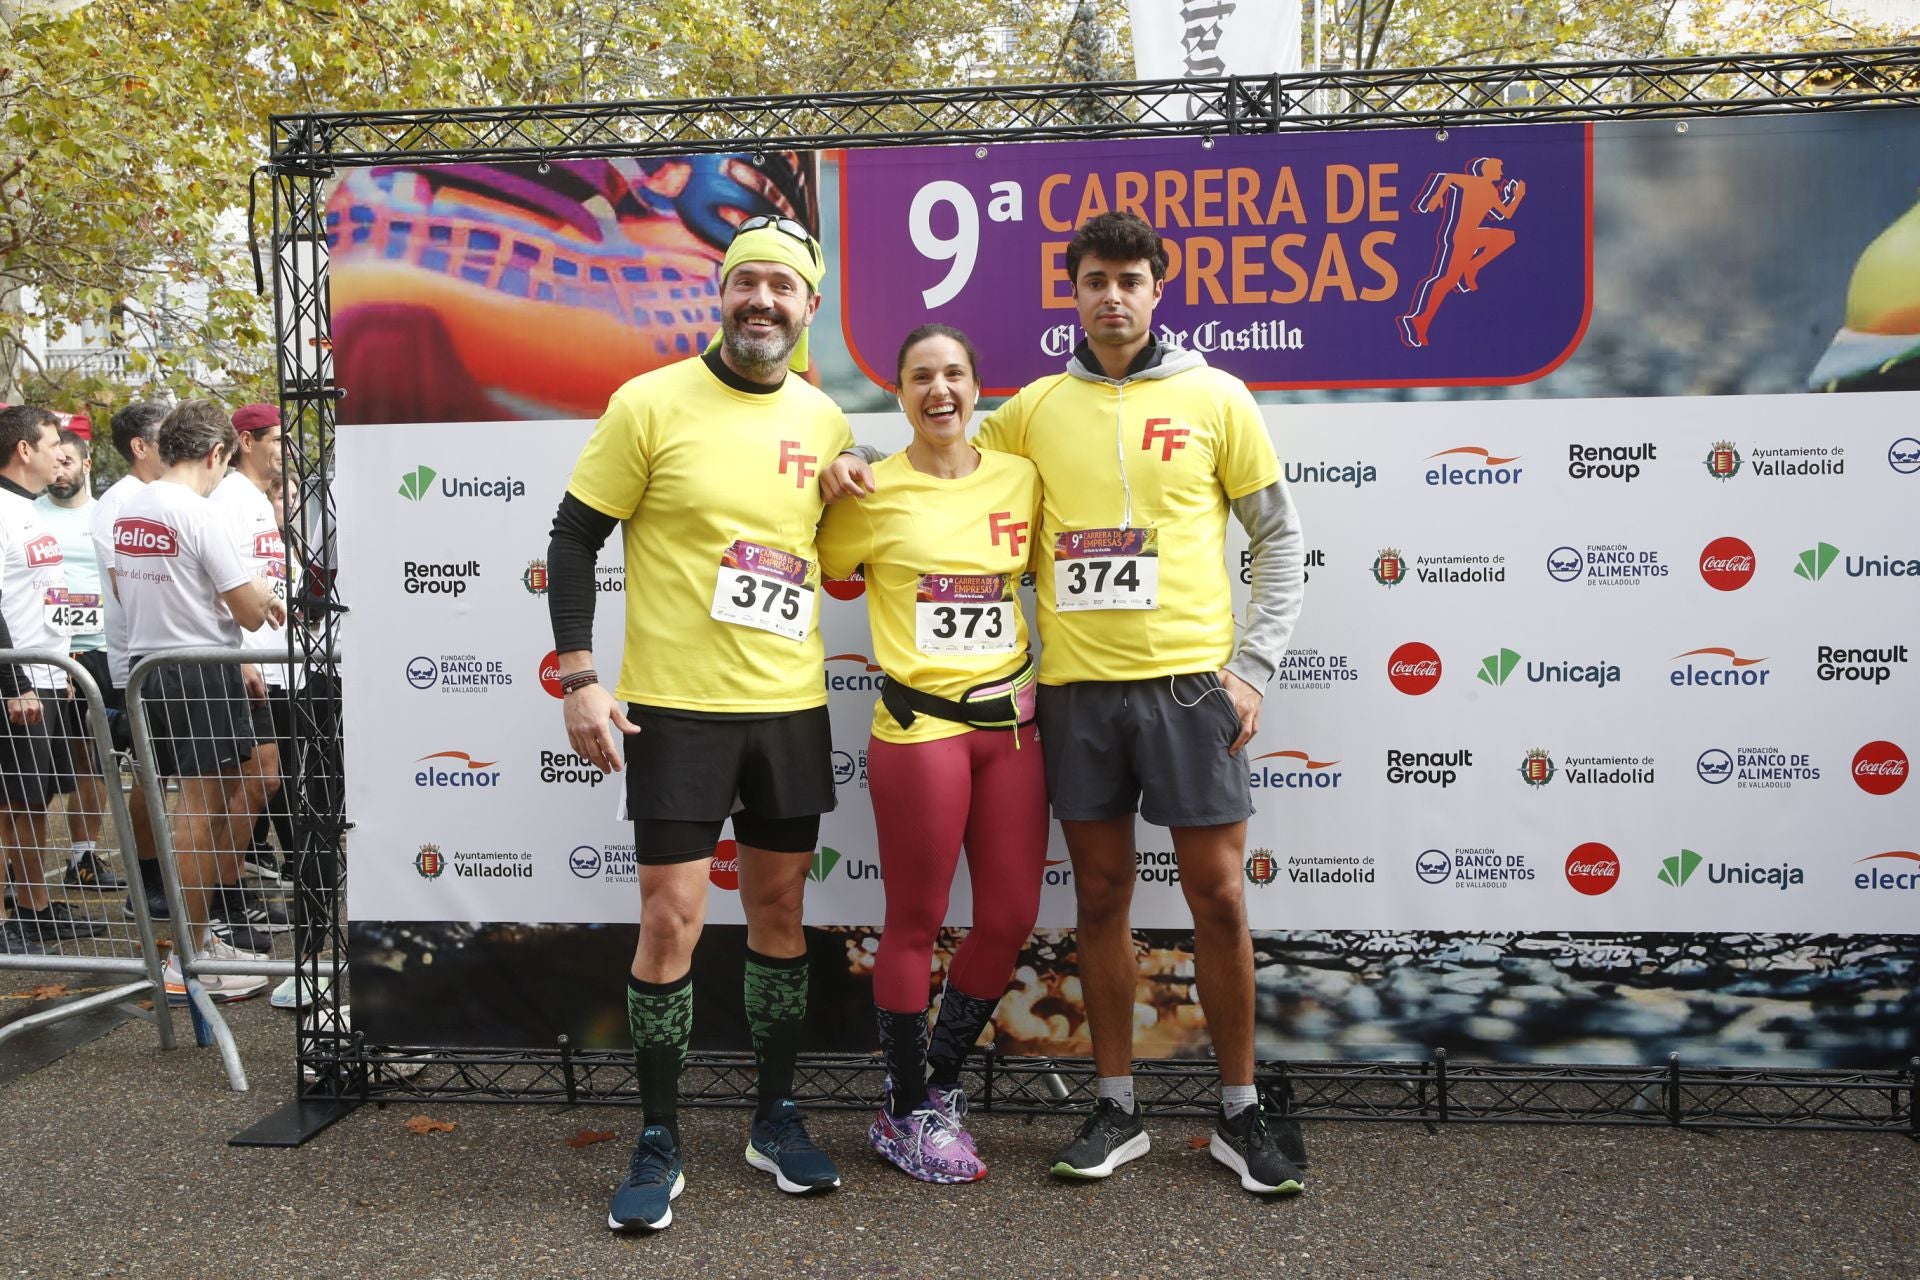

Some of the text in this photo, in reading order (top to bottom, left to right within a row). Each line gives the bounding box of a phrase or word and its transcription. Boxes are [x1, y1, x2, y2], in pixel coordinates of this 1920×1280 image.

[1038, 163, 1400, 232] CARRERA DE
[1040, 324, 1075, 357] El
[1193, 319, 1305, 353] Castilla
[1570, 443, 1656, 463] Renault
[1752, 446, 1844, 458] Ayuntamiento de
[1285, 461, 1376, 488] Unicaja
[1426, 462, 1522, 485] elecnor
[1569, 462, 1640, 482] Group
[1752, 457, 1844, 476] Valladolid
[442, 476, 525, 502] Unicaja
[113, 526, 171, 550] Helios
[1083, 538, 1122, 548] EMPRESAS
[758, 556, 794, 573] EMPRESAS
[1417, 554, 1505, 566] Ayuntamiento de
[1587, 552, 1657, 564] BANCO DE
[1702, 555, 1752, 573] Coca-Cola
[1846, 555, 1920, 577] Unica
[142, 571, 175, 584] origen.
[405, 561, 480, 577] Renault
[1067, 560, 1140, 595] 374
[1417, 567, 1504, 583] Valladolid
[1588, 565, 1668, 577] ALIMENTOS
[404, 576, 466, 597] Group
[954, 585, 993, 594] EMPRESAS
[731, 575, 801, 621] 375
[932, 606, 1002, 639] 373
[1280, 656, 1348, 668] BANCO DE
[1818, 645, 1908, 663] Renault
[440, 661, 502, 673] BANCO DE
[1280, 669, 1358, 682] ALIMENTOS
[1391, 660, 1439, 677] Coca-Cola
[1527, 661, 1620, 688] Unicaja
[1671, 662, 1769, 686] elecnor
[1817, 664, 1890, 685] Group
[442, 674, 512, 685] ALIMENTOS
[1279, 682, 1331, 690] DE VALLADOLID
[1388, 750, 1472, 766] Renault
[1566, 756, 1654, 767] Ayuntamiento de
[1738, 755, 1809, 766] BANCO DE
[415, 766, 500, 786] elecnor
[539, 766, 604, 788] Group
[1566, 769, 1654, 783] Valladolid
[1738, 768, 1820, 779] ALIMENTOS
[1855, 760, 1904, 777] Coca-Cola
[1250, 766, 1342, 789] elecnor
[1387, 767, 1456, 788] Group
[454, 852, 532, 861] Ayuntamiento de
[605, 852, 637, 863] BANC
[1288, 856, 1374, 866] Ayuntamiento de
[1456, 856, 1524, 867] BANCO DE
[454, 863, 532, 877] Valladolid
[1288, 868, 1374, 883] Valladolid
[1456, 869, 1535, 880] ALIMENTOS
[1568, 860, 1616, 877] Coca-Cola
[1709, 863, 1803, 890] Unicaja
[1855, 866, 1920, 889] elecn
